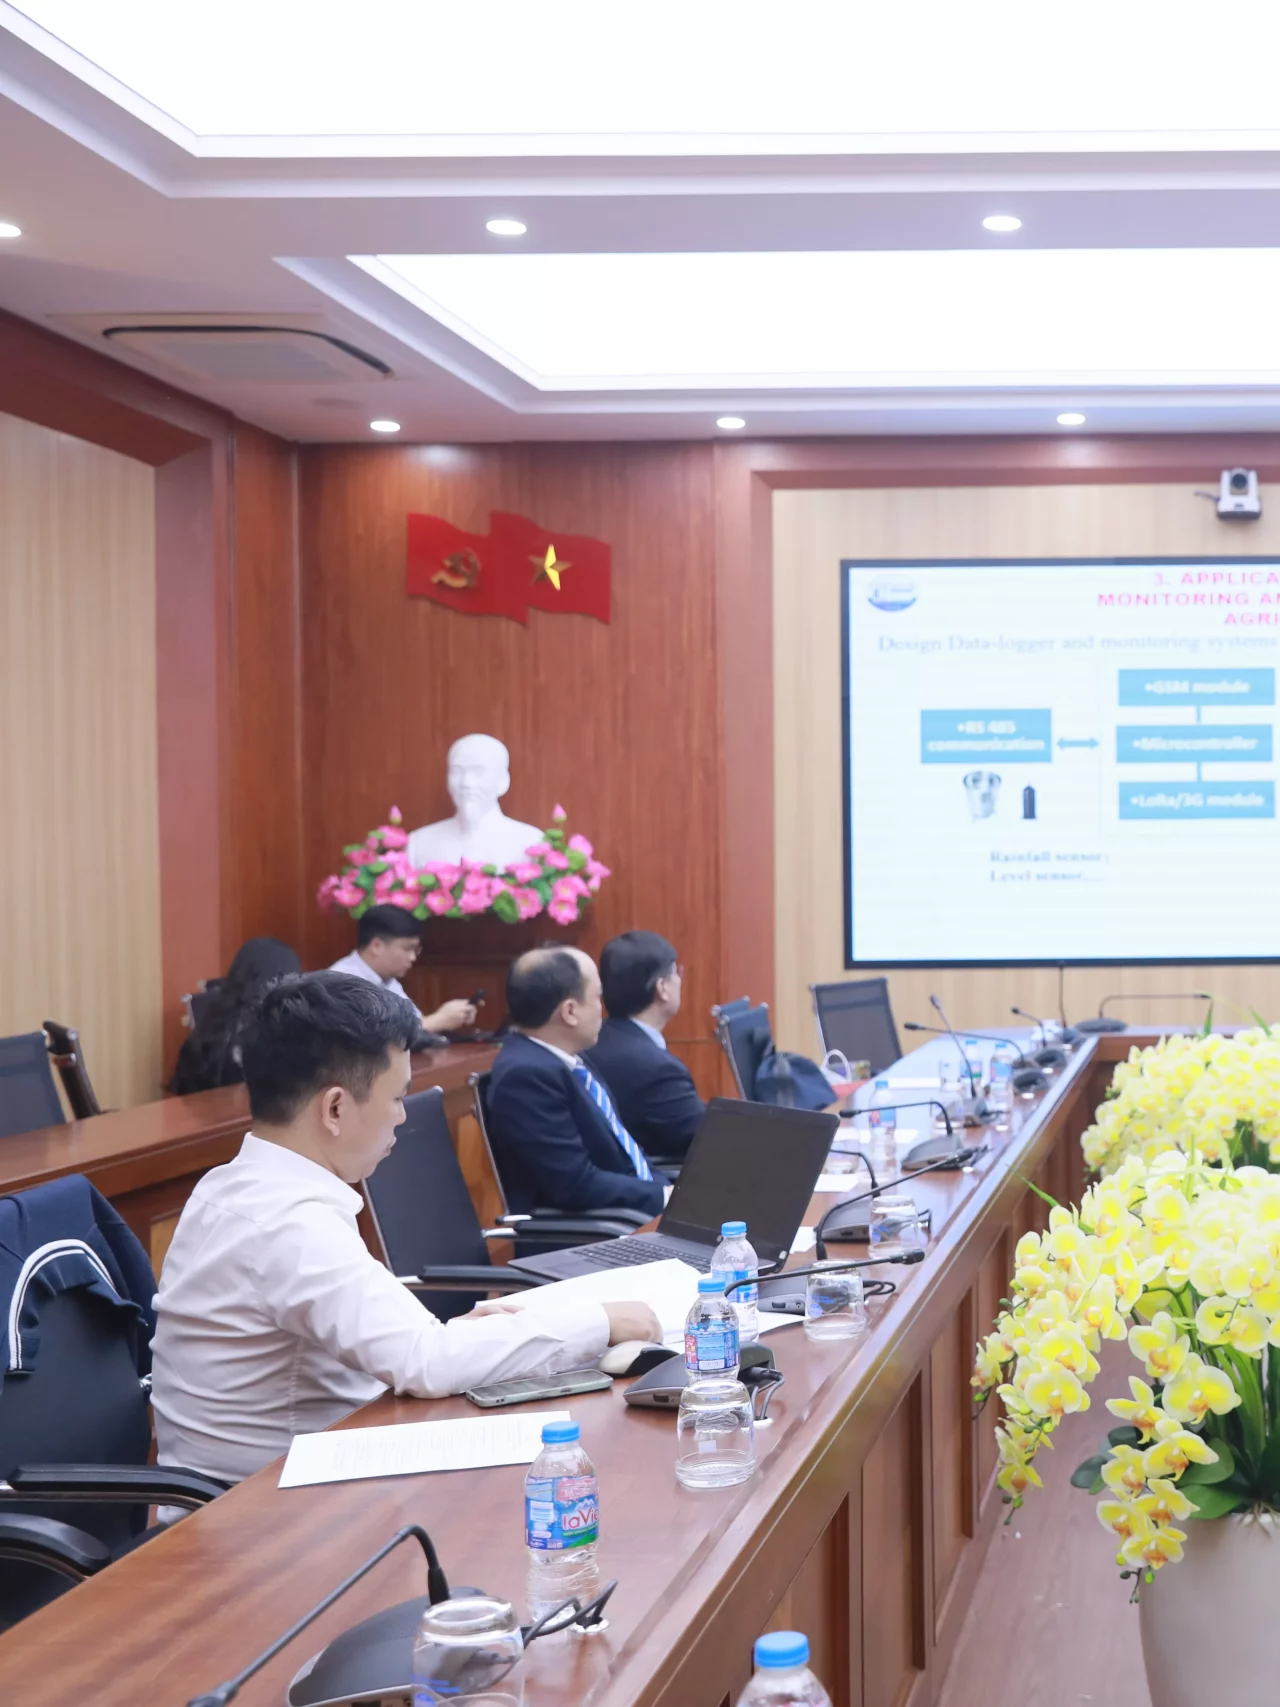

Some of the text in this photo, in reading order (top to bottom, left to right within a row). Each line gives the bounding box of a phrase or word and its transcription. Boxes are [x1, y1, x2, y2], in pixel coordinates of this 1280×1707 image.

[1154, 572, 1170, 586] 3.
[1097, 592, 1249, 606] MONITORING
[878, 634, 1278, 653] Design Data-logger and monitoring systems
